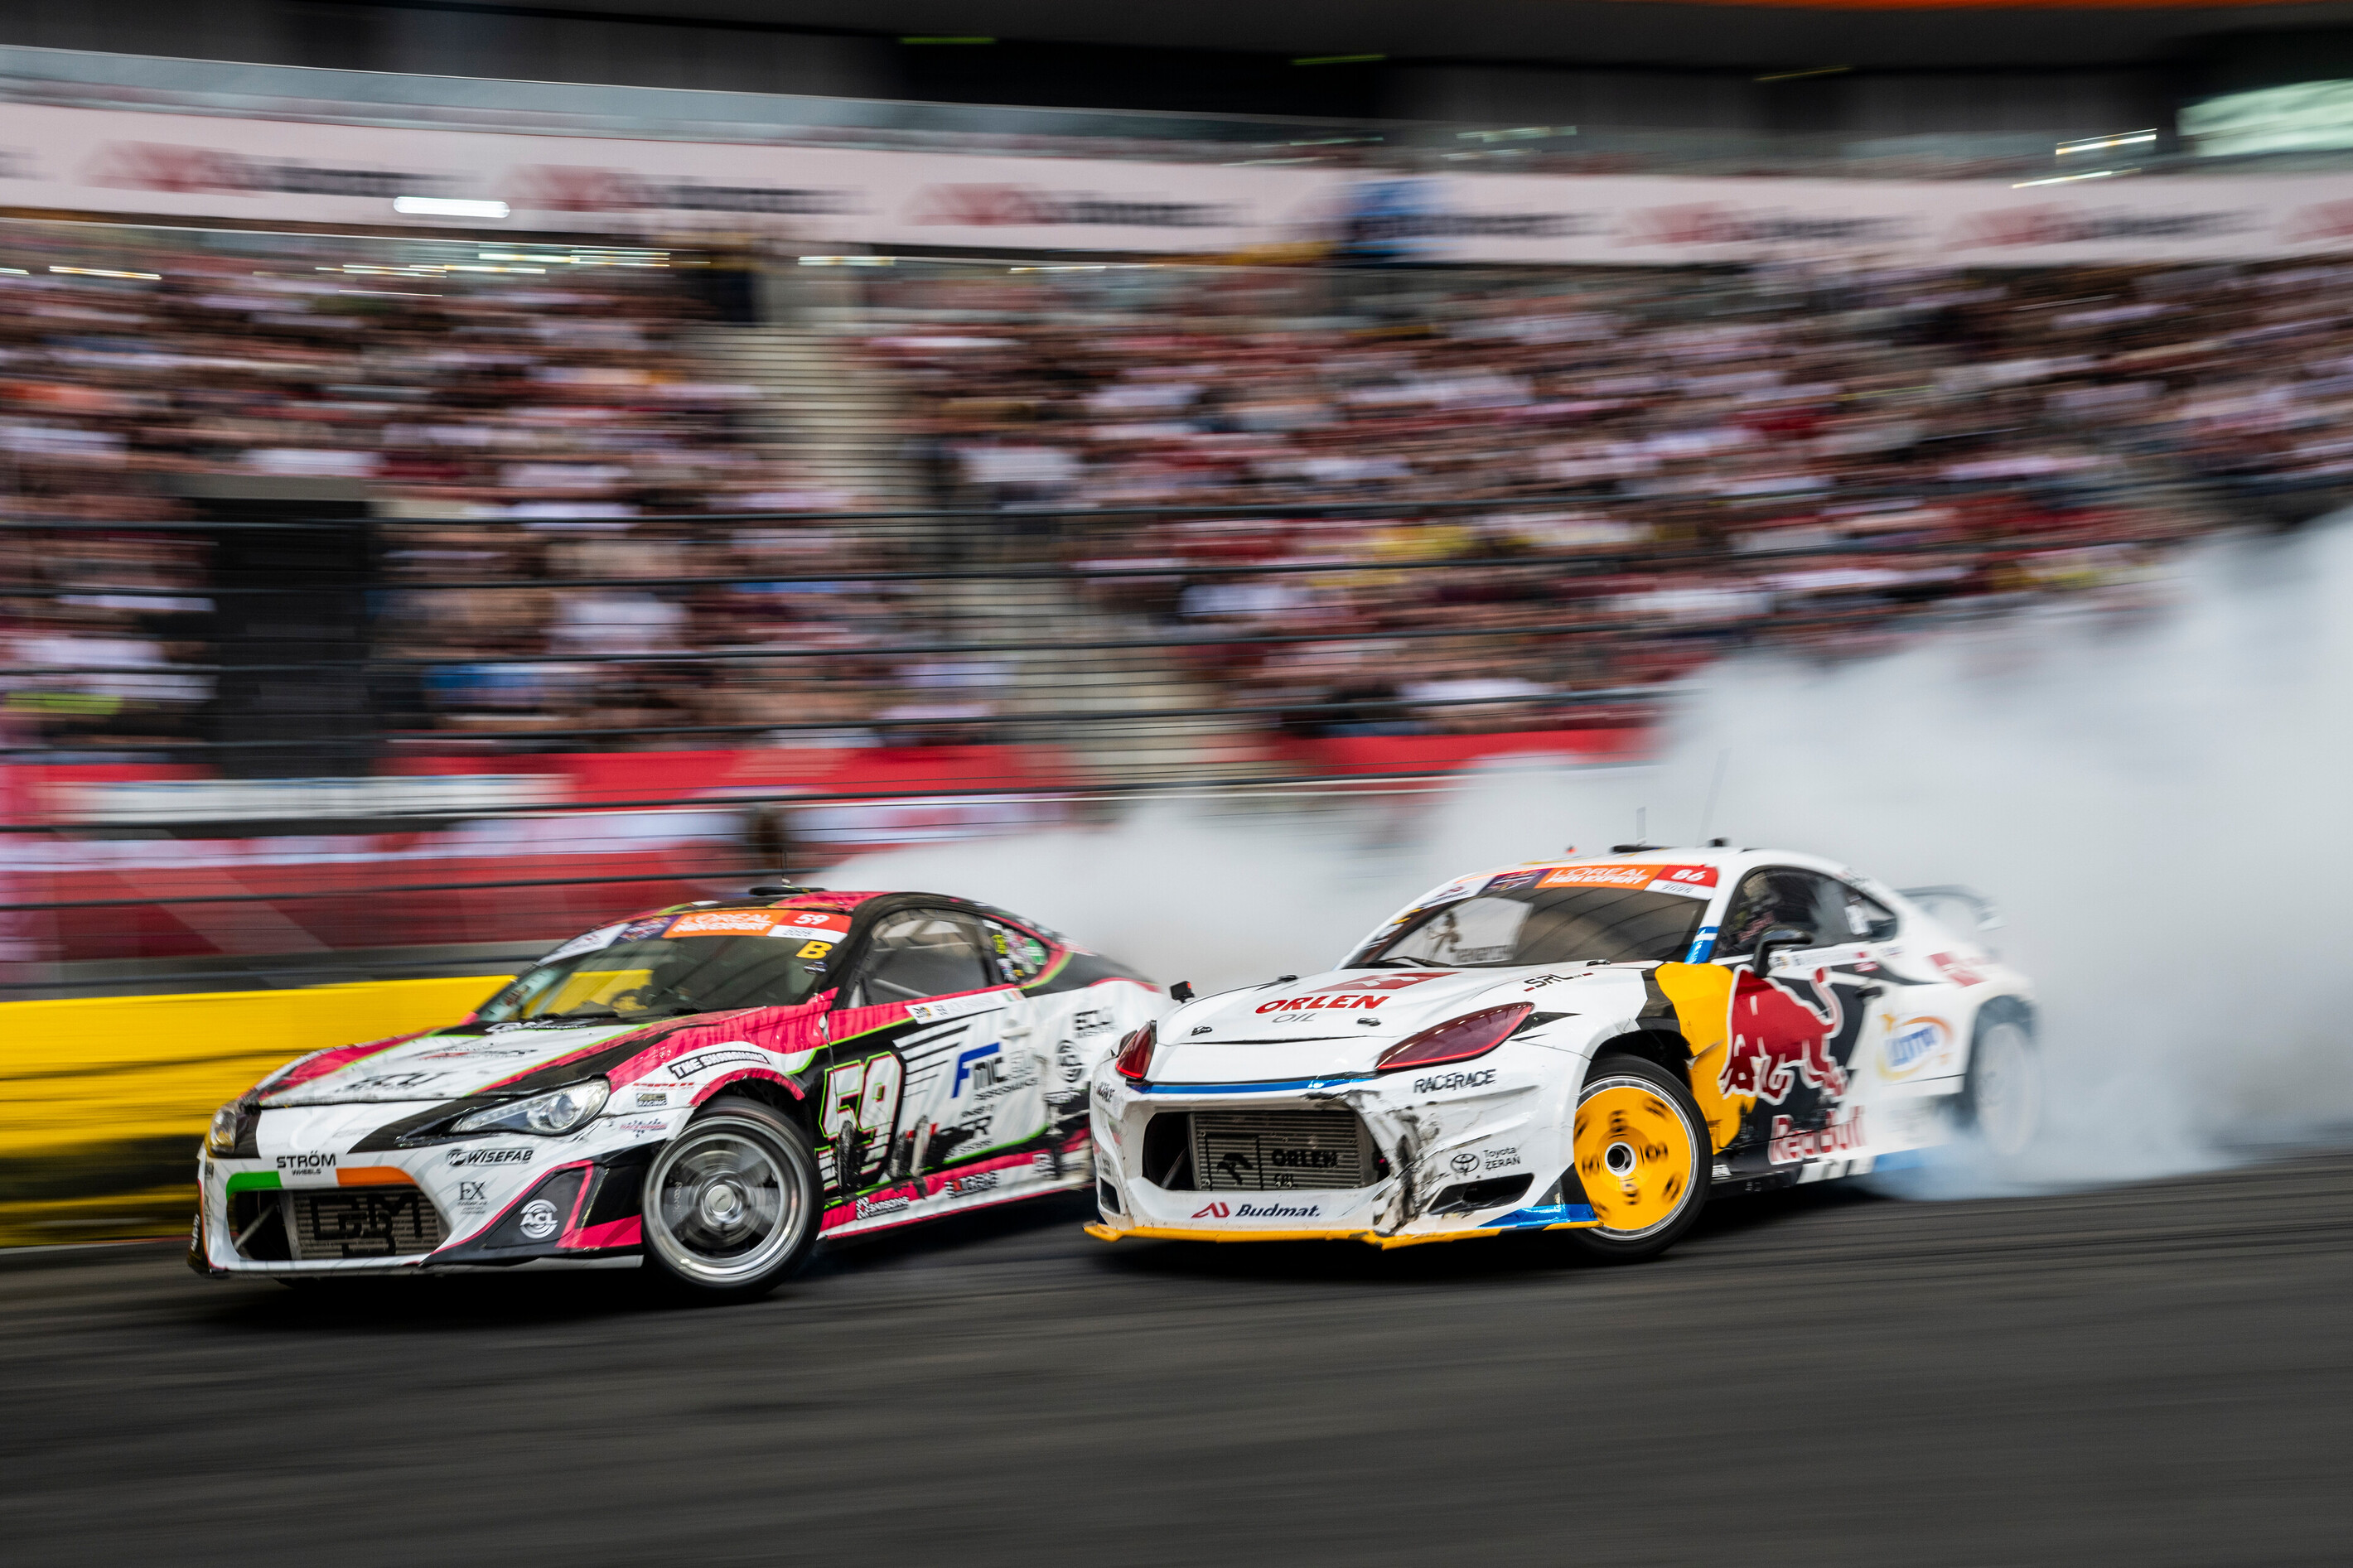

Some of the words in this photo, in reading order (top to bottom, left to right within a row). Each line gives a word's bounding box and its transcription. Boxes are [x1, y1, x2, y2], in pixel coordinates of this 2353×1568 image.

[1671, 869, 1707, 882] 86
[794, 914, 830, 926] 59
[795, 940, 833, 959] B
[1524, 973, 1574, 988] SRL
[1254, 995, 1391, 1015] ORLEN
[1272, 1012, 1317, 1023] OIL
[671, 1058, 703, 1078] THE
[815, 1052, 903, 1191] 59
[1768, 1114, 1821, 1165] Red
[1820, 1106, 1869, 1159] Bull
[276, 1150, 336, 1169] STRÖM
[467, 1149, 534, 1165] WISEFAB
[1483, 1147, 1517, 1159] Toyota
[292, 1168, 322, 1176] WHEELS
[1234, 1204, 1321, 1218] Budmat.
[519, 1212, 558, 1227] ACL
